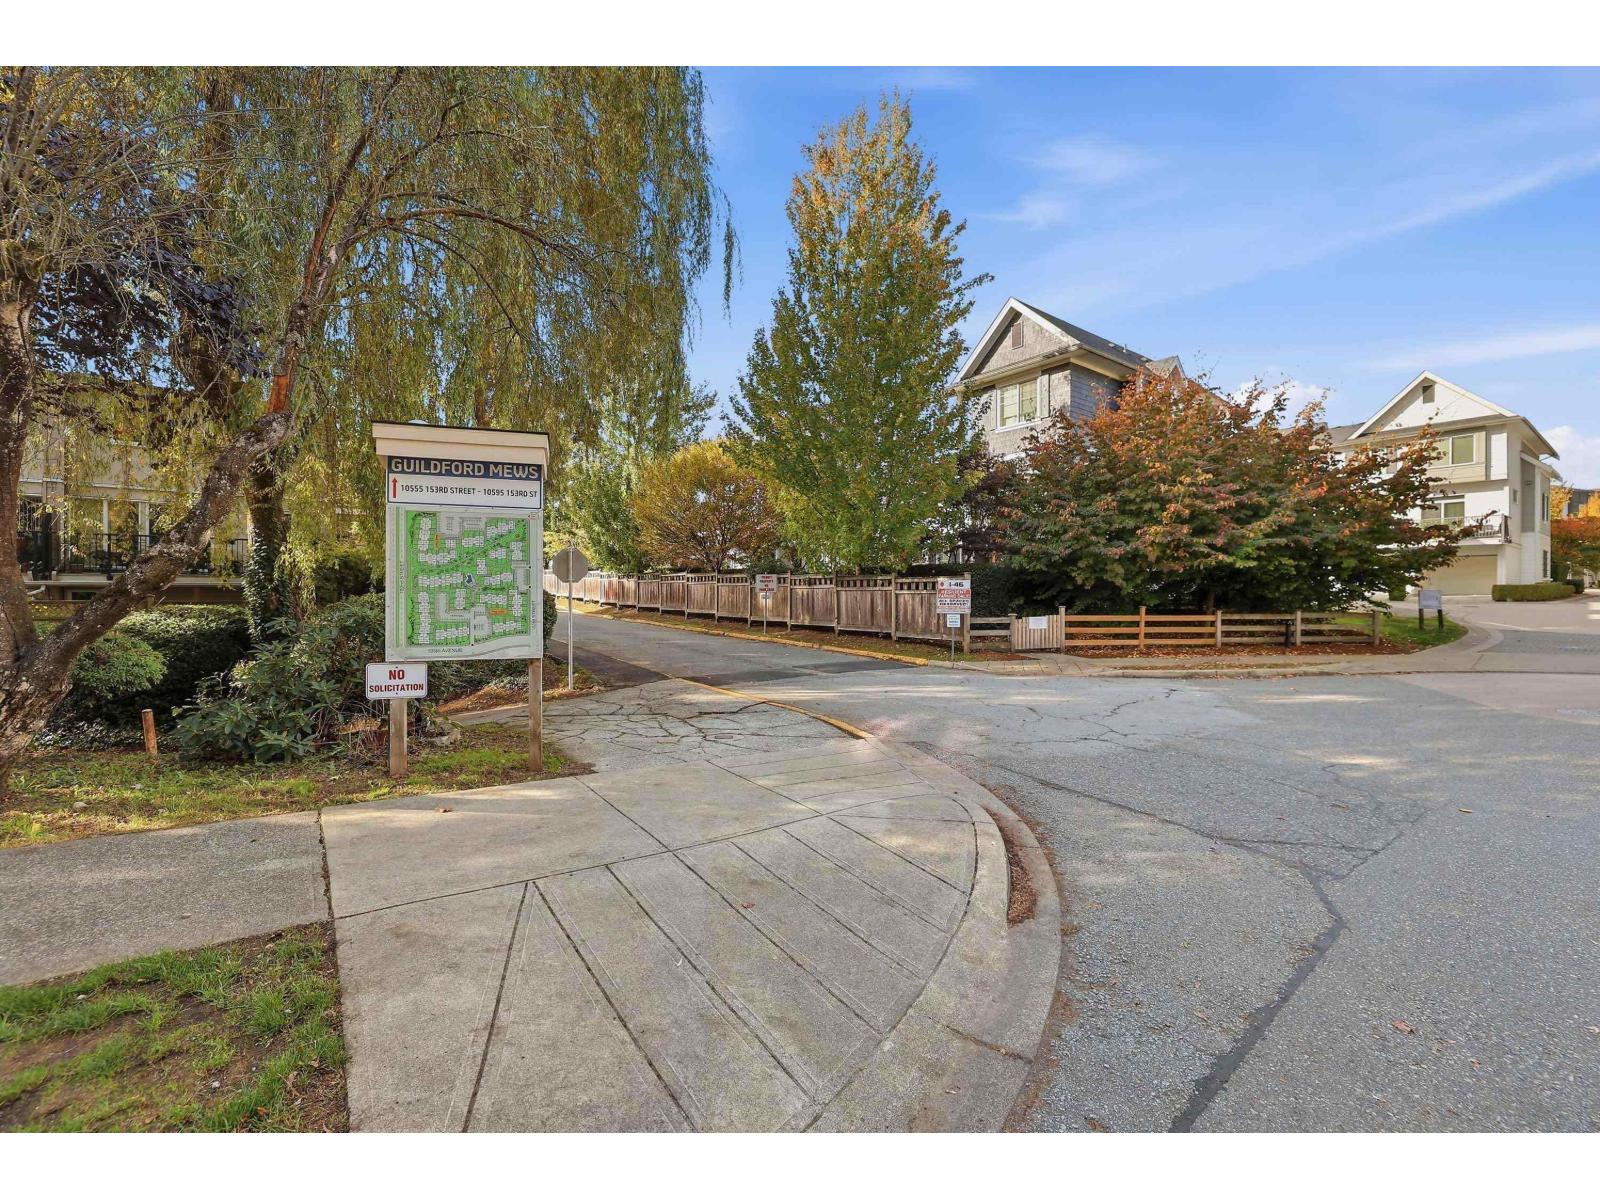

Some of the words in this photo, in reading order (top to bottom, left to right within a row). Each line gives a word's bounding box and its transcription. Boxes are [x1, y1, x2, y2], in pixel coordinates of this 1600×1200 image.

[391, 458, 485, 477] GUILDFORD
[489, 464, 539, 479] MEWS
[401, 484, 424, 493] 10555
[425, 485, 449, 494] 153RD
[450, 486, 476, 495] STREET
[483, 488, 505, 497] 10595
[506, 489, 528, 498] 153RD
[529, 490, 538, 498] ST
[388, 669, 405, 680] NO
[369, 683, 424, 693] SOLICITATION
